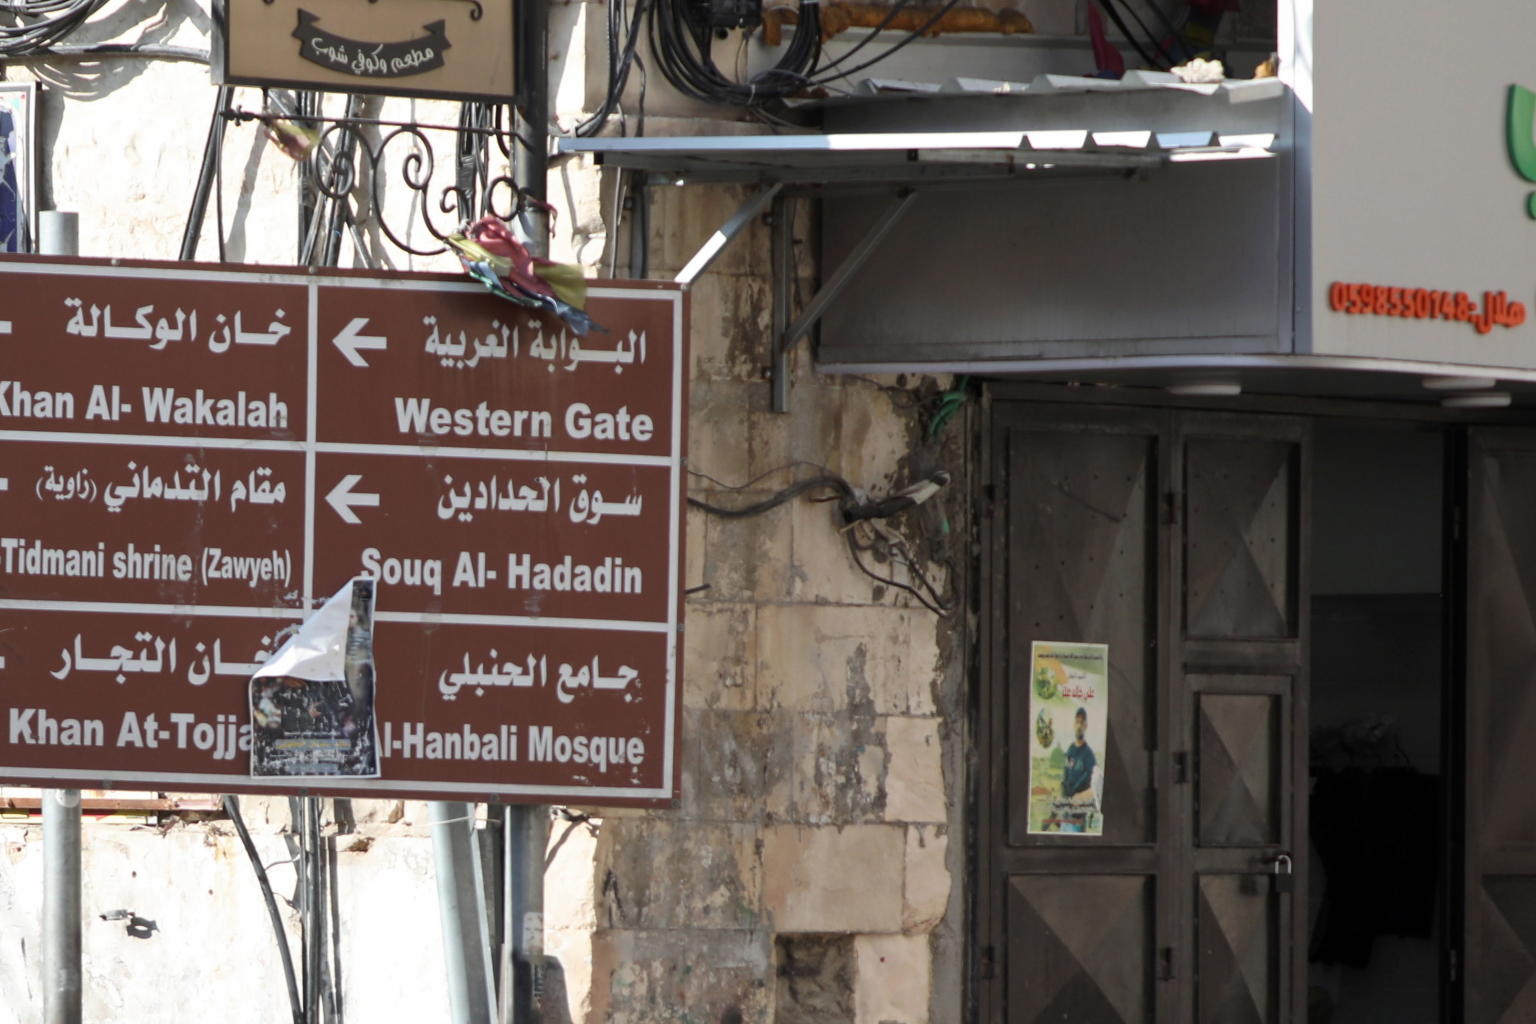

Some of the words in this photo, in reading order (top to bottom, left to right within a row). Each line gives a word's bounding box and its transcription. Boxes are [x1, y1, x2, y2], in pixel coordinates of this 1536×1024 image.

[311, 37, 349, 64] شوب
[391, 47, 435, 73] مطعم
[64, 297, 197, 350] الوكالة
[208, 307, 292, 353] خان
[422, 315, 519, 370] الغربية
[528, 319, 647, 374] البوابة
[85, 384, 132, 421] Al-
[142, 387, 288, 429] Wakalah
[394, 397, 552, 439] Western
[565, 402, 654, 442] Gate
[104, 460, 221, 513] التدماني
[230, 466, 287, 513] مقام
[437, 473, 560, 523] الحدادين
[568, 473, 643, 525] سوق
[112, 543, 193, 582] shrine
[201, 547, 293, 588] (Zawyeh)
[361, 547, 443, 596] Souq
[452, 551, 497, 589] Al-
[507, 553, 642, 595] Hadadin
[48, 630, 178, 686] التجار
[438, 648, 548, 701] الحنبلي
[556, 654, 640, 704] جامع
[8, 707, 104, 747] Khan
[116, 710, 252, 761] At-Tojja
[377, 721, 518, 763] l-Hanbali
[528, 725, 646, 774] Mosque
